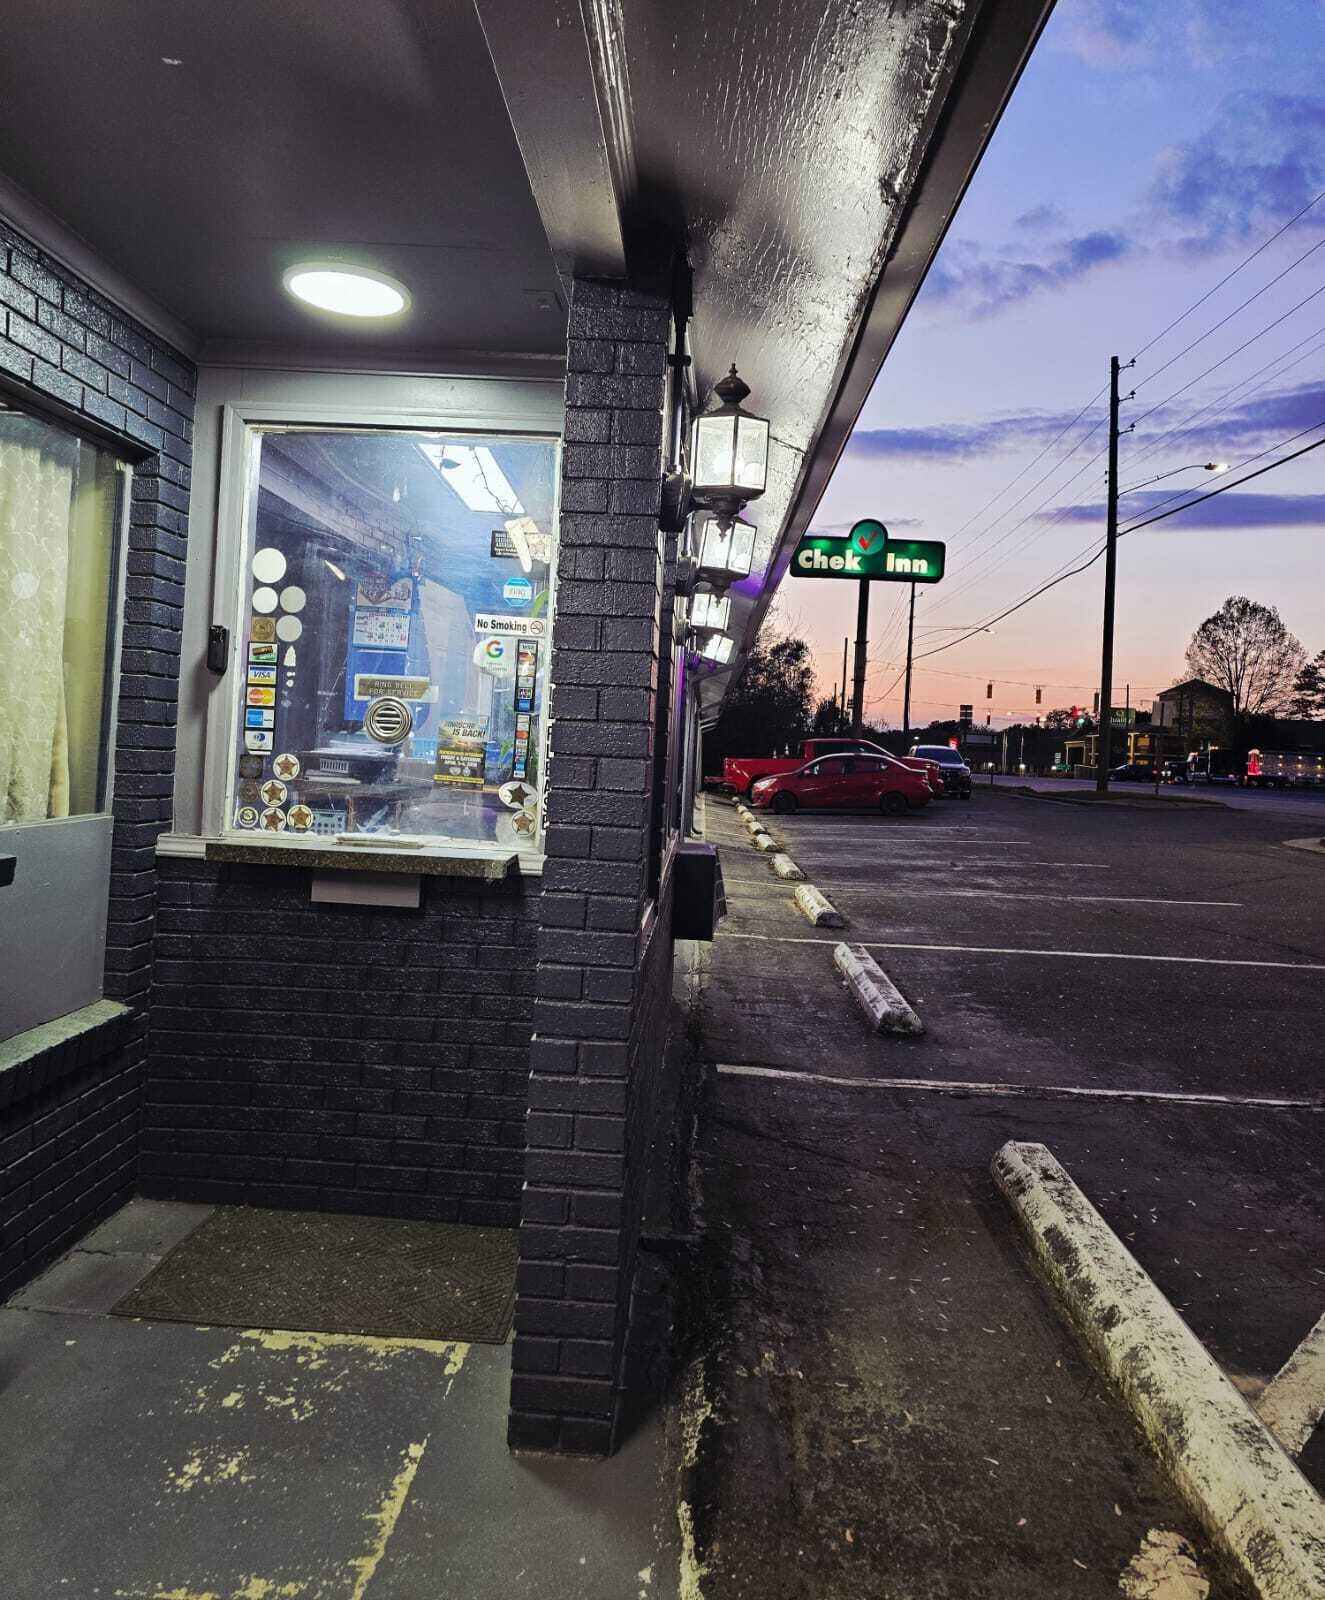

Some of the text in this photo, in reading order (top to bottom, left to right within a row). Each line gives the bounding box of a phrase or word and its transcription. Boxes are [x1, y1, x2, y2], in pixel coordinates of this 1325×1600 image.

[798, 548, 929, 574] Chek Inn
[477, 618, 528, 633] No Smoking
[486, 639, 504, 659] G
[253, 670, 272, 679] VISA
